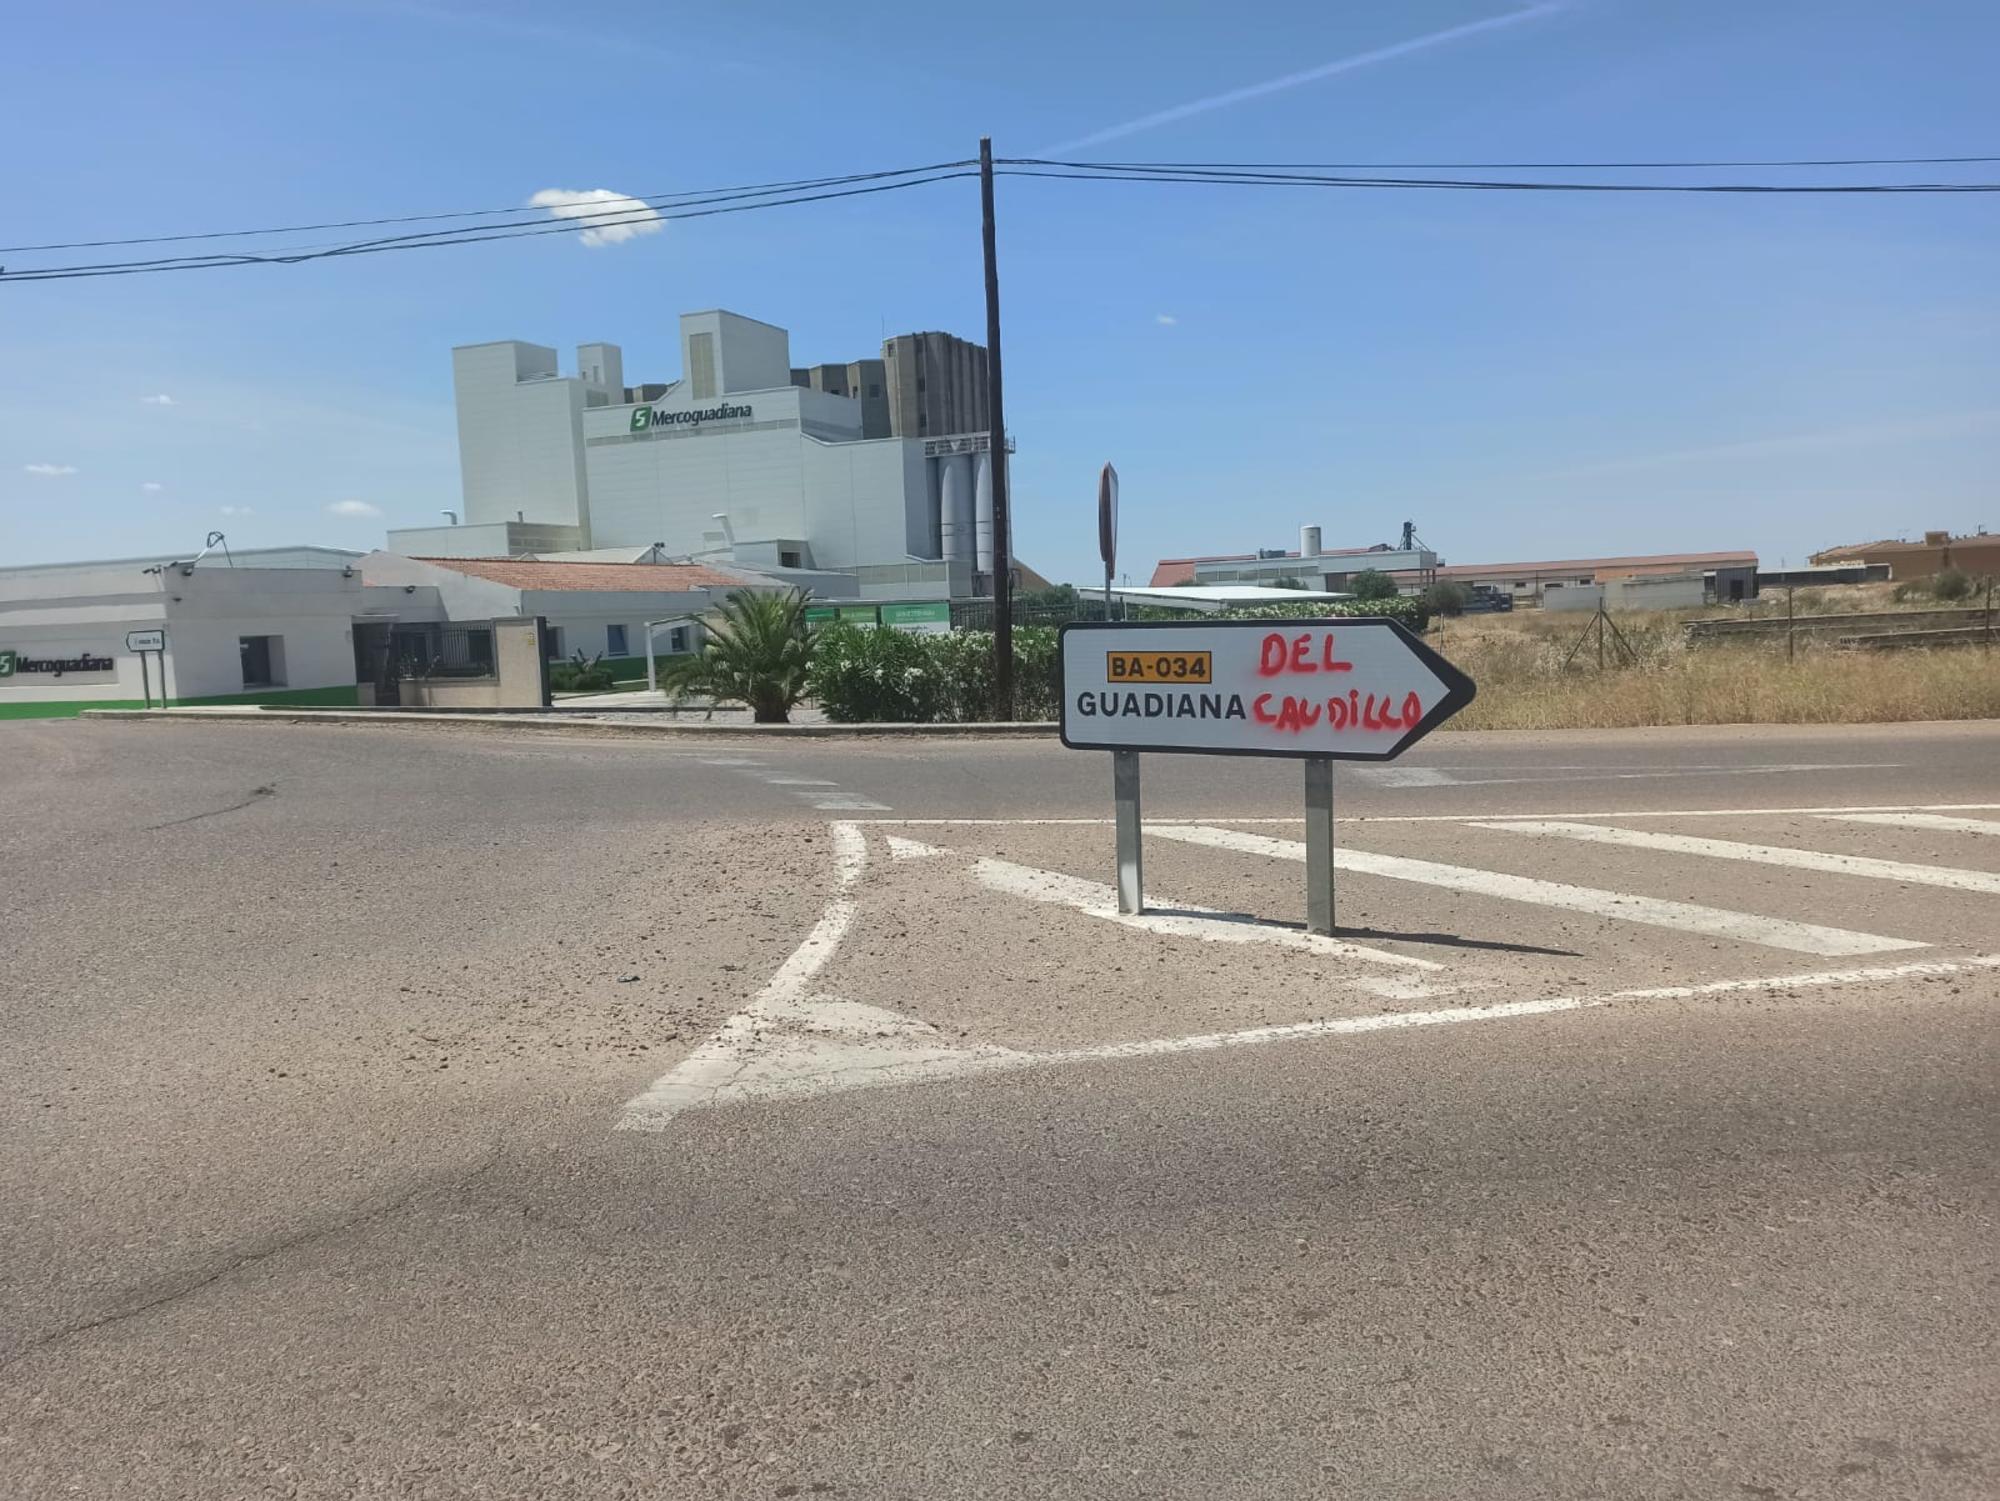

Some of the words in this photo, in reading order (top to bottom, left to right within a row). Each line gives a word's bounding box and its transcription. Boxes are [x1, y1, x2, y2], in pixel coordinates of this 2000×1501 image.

[651, 403, 752, 427] Mercoguadiana
[1111, 656, 1207, 678] BA-034
[1259, 632, 1353, 676] DEL
[1076, 692, 1247, 720] GUADIANA
